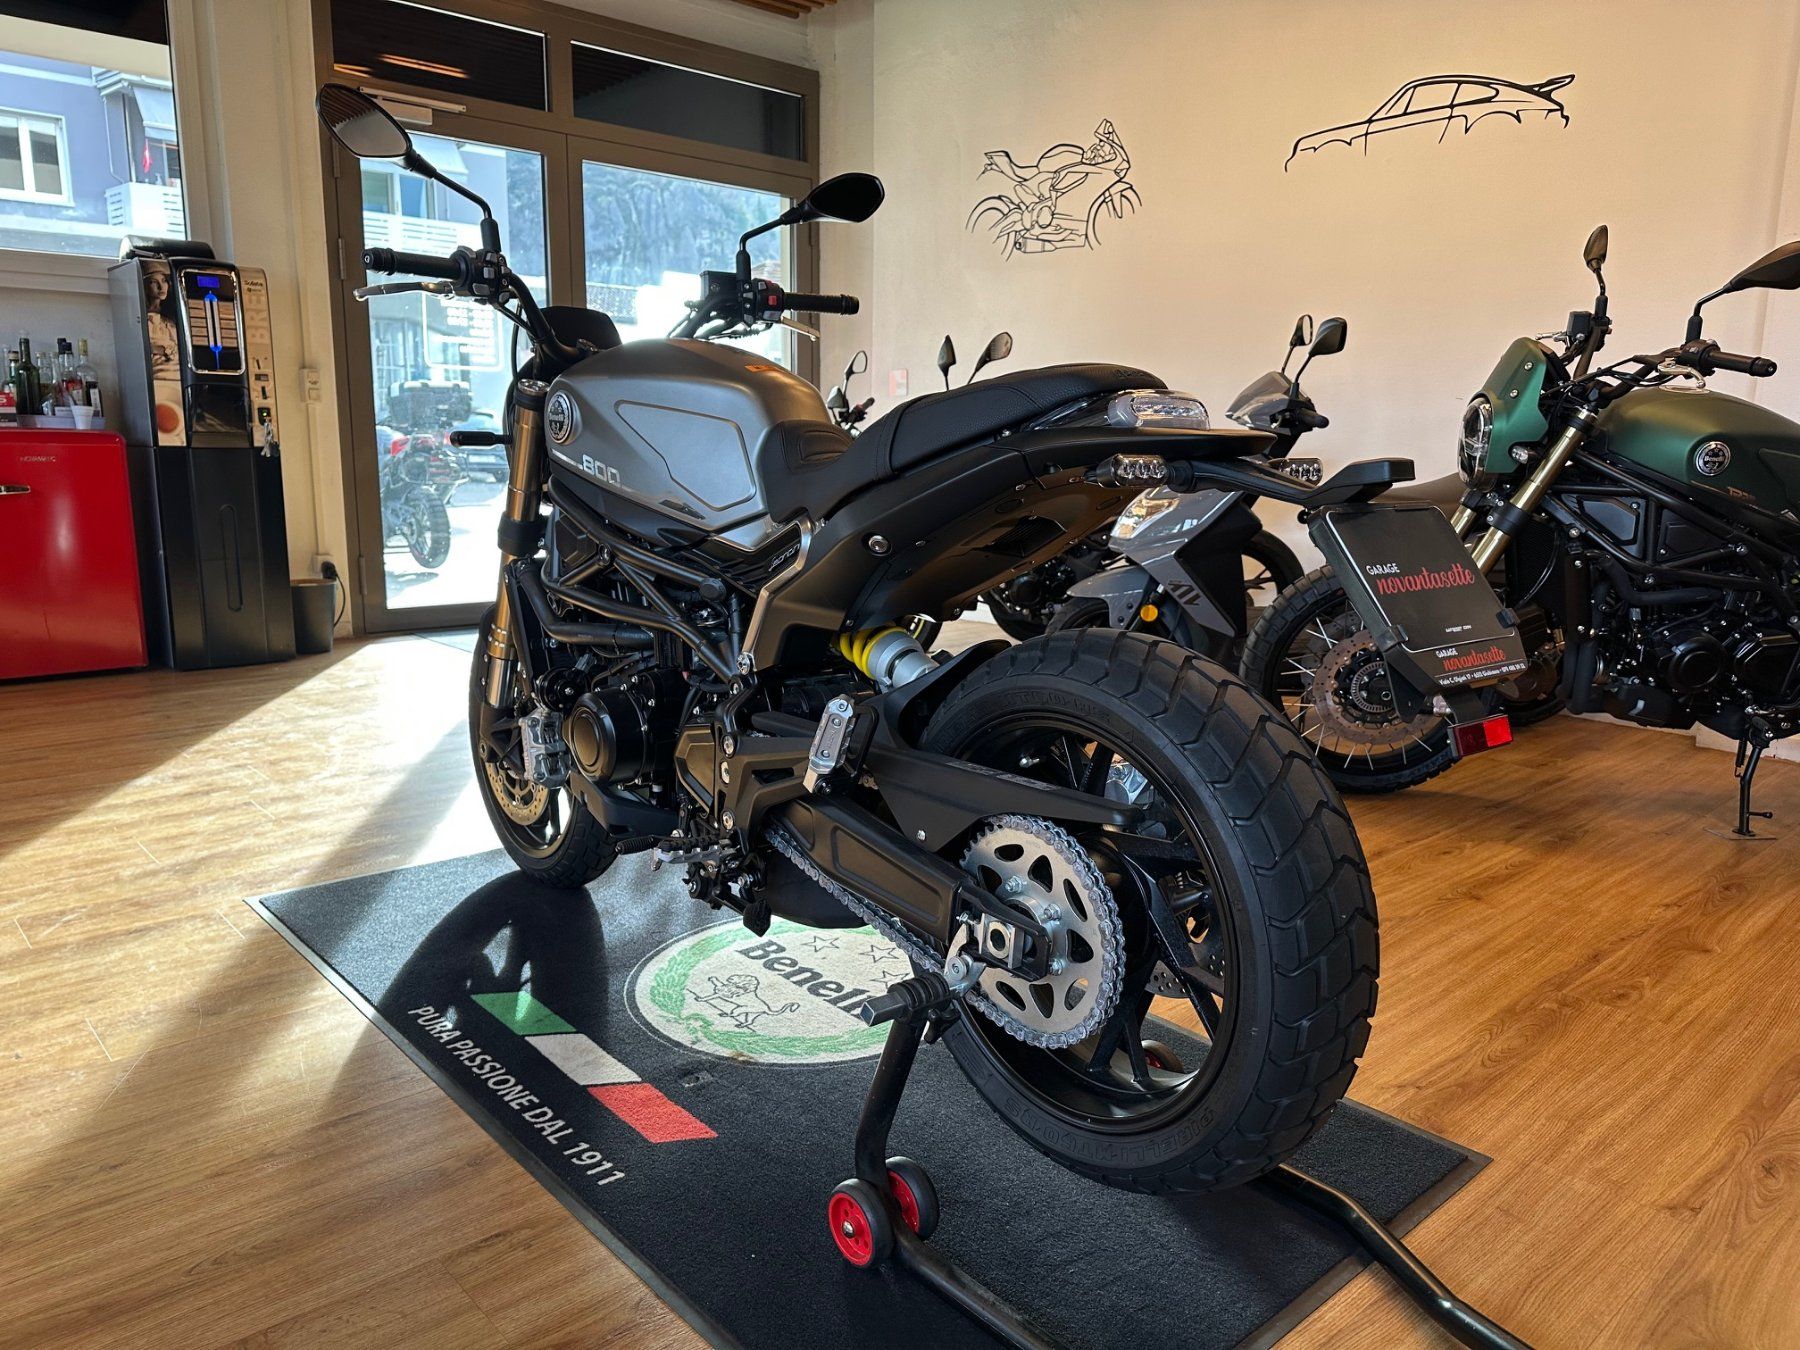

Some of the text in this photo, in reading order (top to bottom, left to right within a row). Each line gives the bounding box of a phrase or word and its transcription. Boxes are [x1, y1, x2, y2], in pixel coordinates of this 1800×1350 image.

[581, 454, 621, 485] 800
[1366, 562, 1400, 575] GARAGE
[1376, 563, 1475, 596] novantasette
[1435, 647, 1458, 658] GARAGE
[1443, 645, 1507, 671] novantasette
[735, 939, 876, 1022] Benell
[408, 1005, 627, 1186] PURA PASSIONE DAL 1911
[1121, 1107, 1216, 1164] PIRELLI
